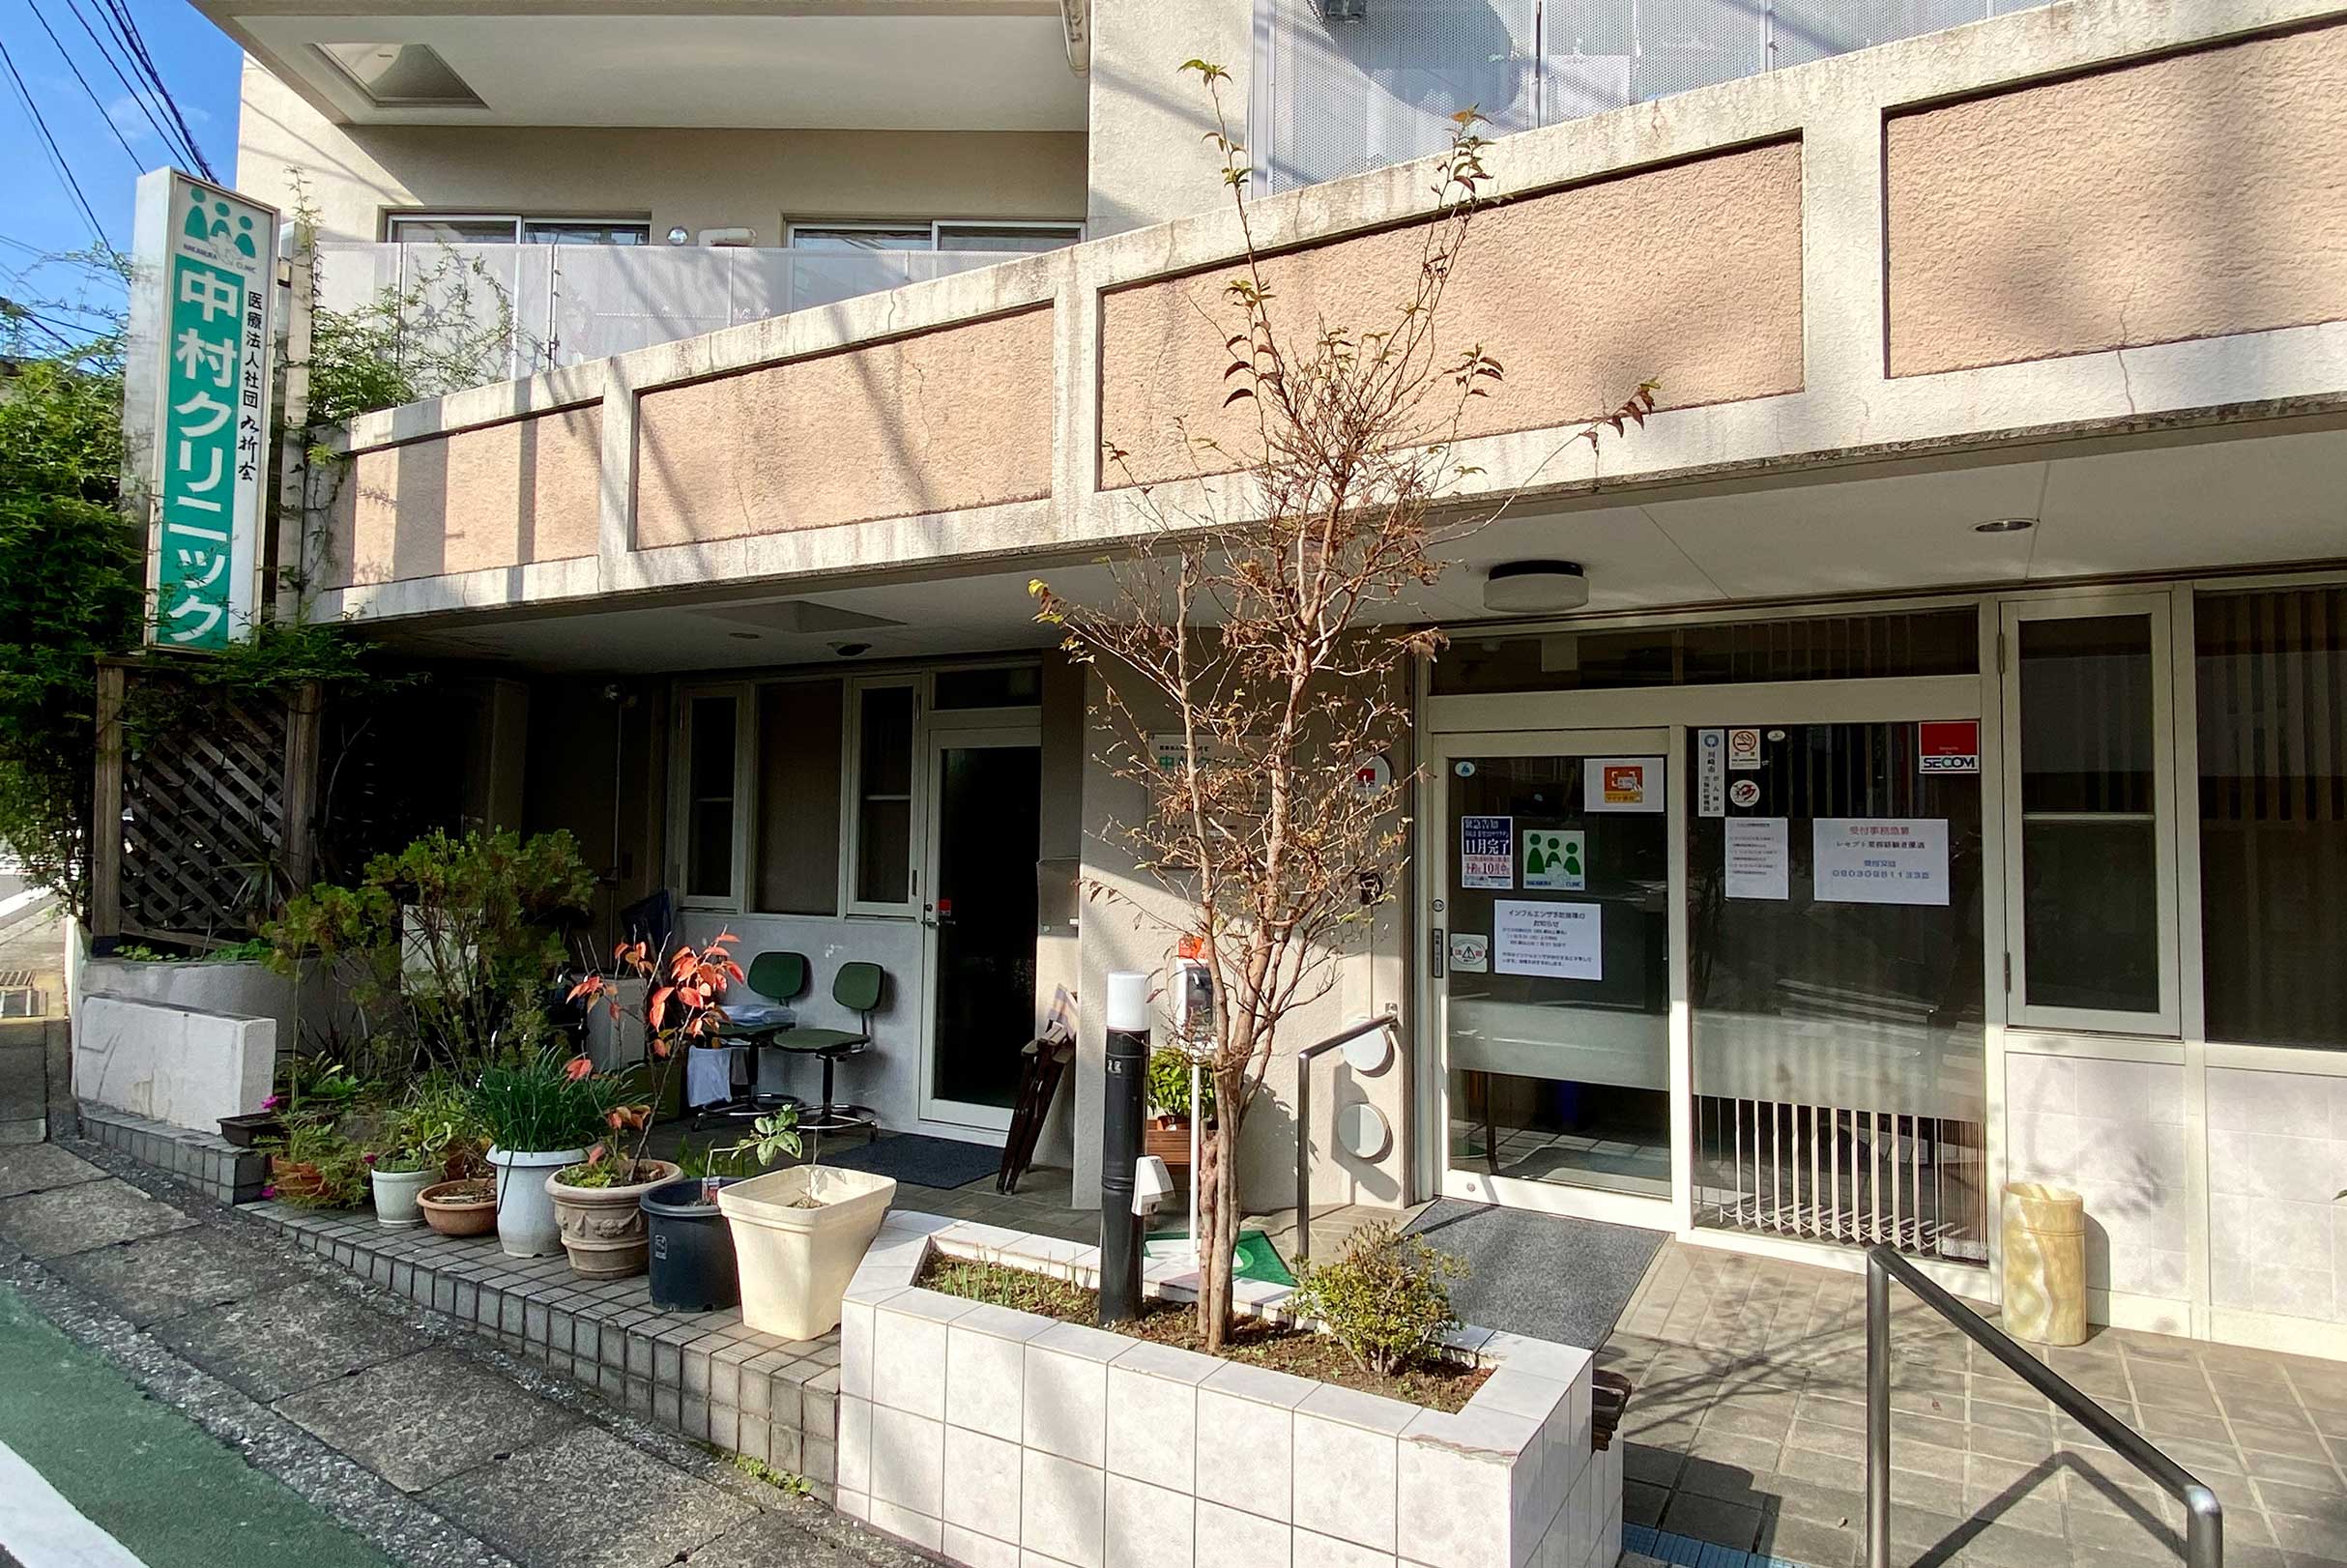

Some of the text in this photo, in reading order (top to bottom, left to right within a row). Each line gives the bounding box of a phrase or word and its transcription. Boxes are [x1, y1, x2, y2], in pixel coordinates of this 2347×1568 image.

[167, 270, 240, 643] 中村クリニック
[1924, 757, 1975, 768] SECOM
[1465, 838, 1510, 856] 11月完了
